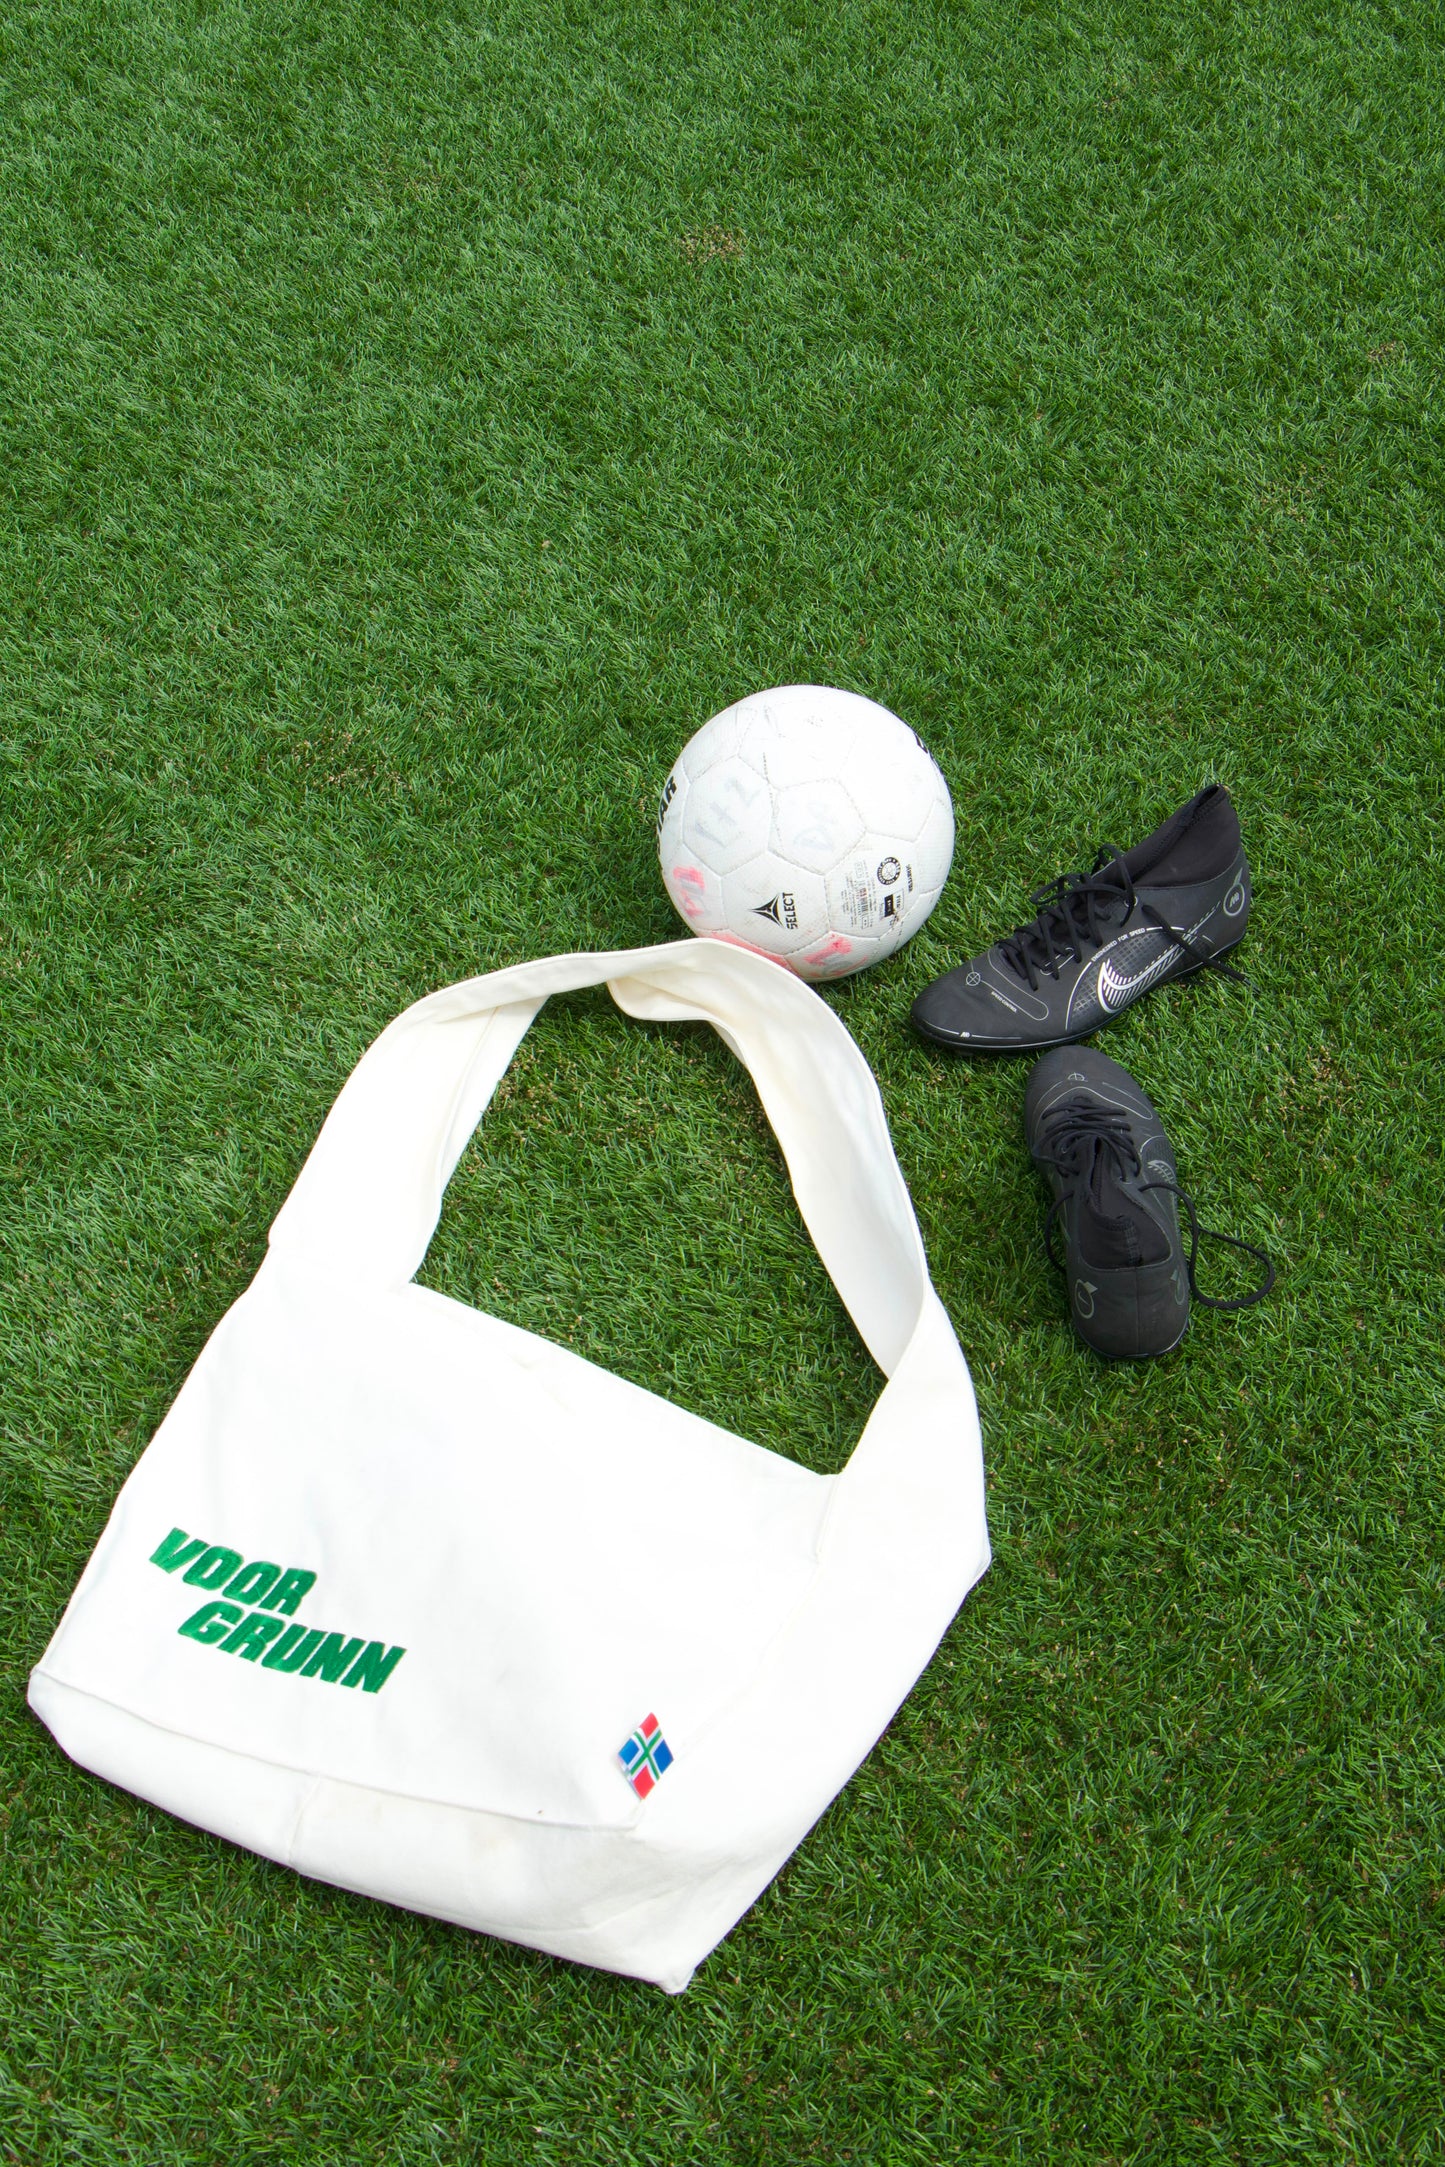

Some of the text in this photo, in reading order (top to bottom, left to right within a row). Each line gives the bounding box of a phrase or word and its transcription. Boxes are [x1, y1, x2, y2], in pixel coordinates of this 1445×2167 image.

[783, 891, 799, 930] SELECT
[149, 1527, 318, 1617] VOOR
[177, 1600, 407, 1694] GRUNN
